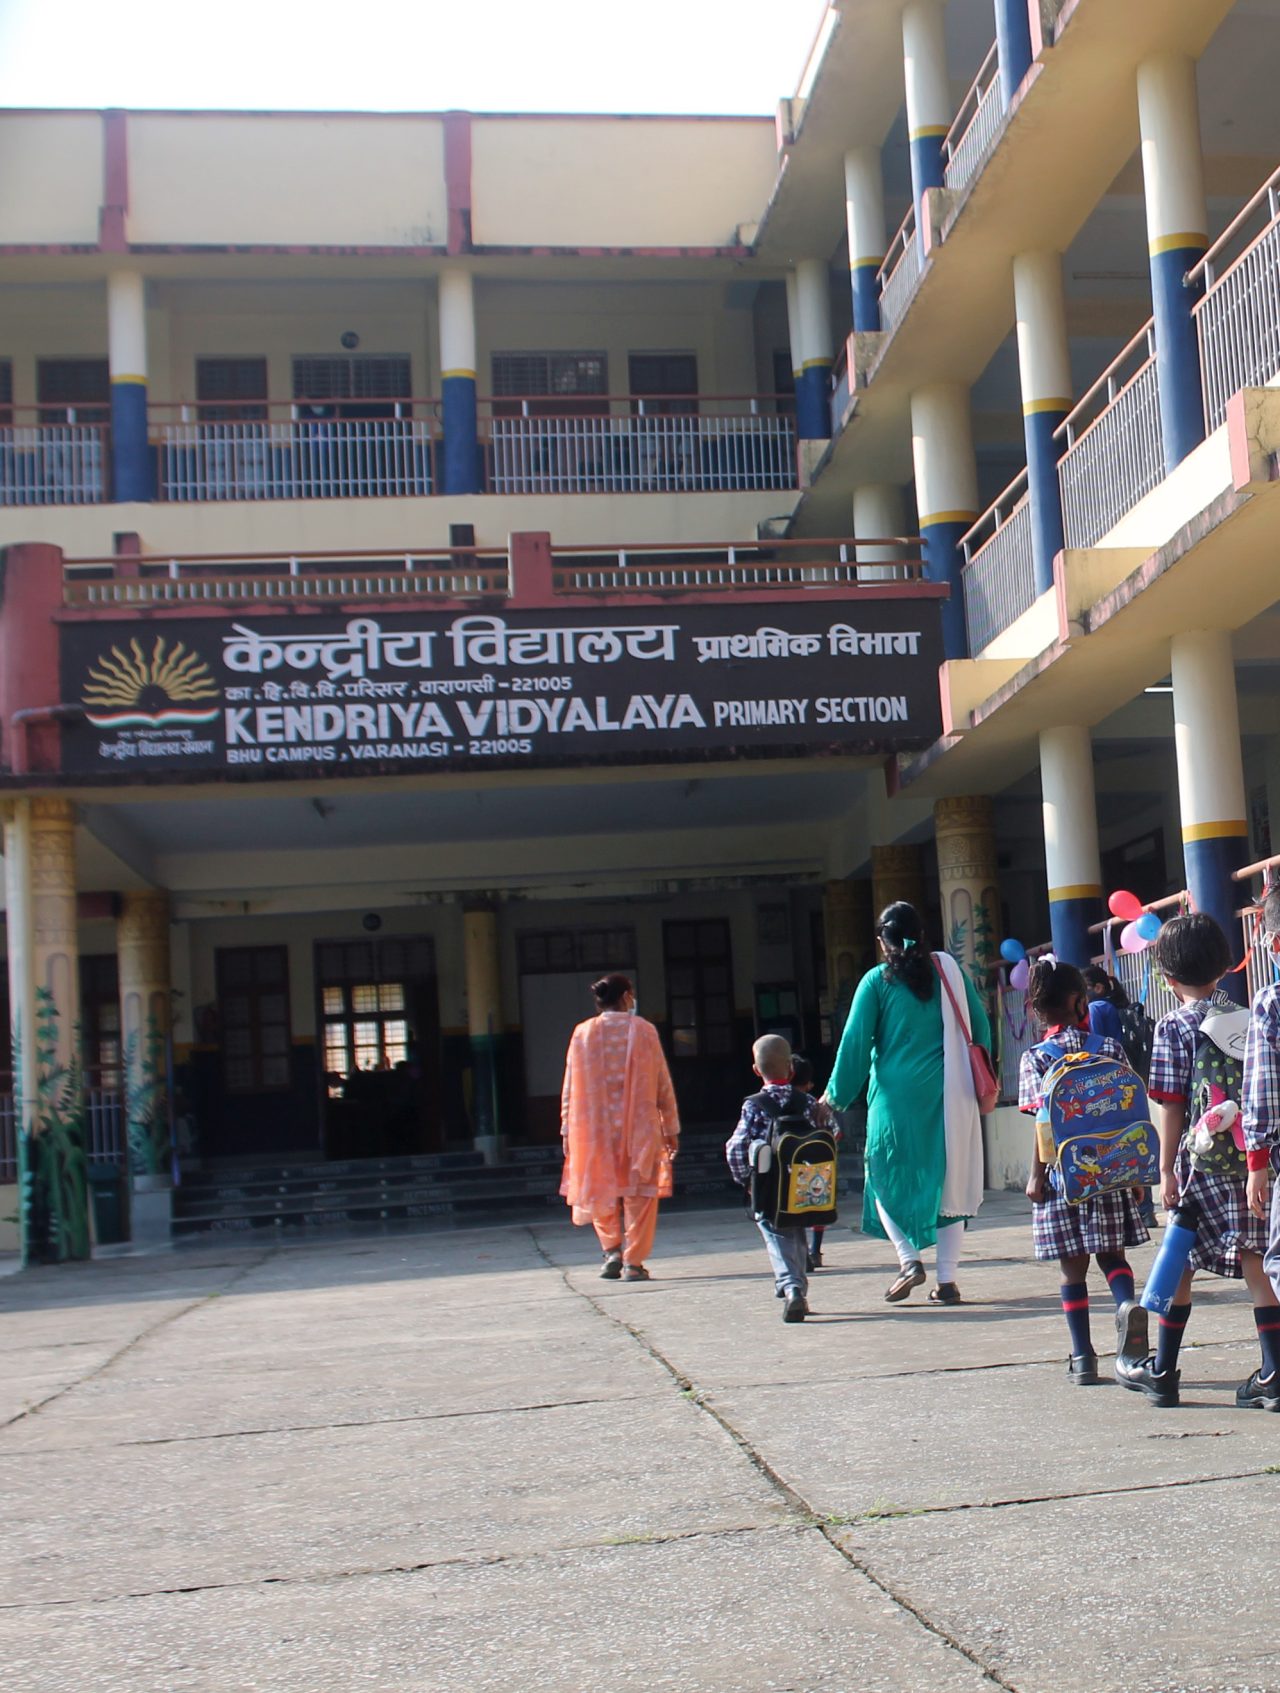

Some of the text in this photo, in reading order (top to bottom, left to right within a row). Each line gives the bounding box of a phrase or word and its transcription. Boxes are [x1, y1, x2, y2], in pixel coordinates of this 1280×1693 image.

[222, 615, 922, 681] केन्द्रीय विद्यालय प्राथमिक विभाग
[511, 676, 573, 692] 221005
[224, 693, 909, 745] KENDRIYA VIDYALAYA PRIMARY SECTION
[226, 748, 262, 764] BHU
[349, 740, 449, 759] VARANASI
[469, 738, 532, 755] 221005
